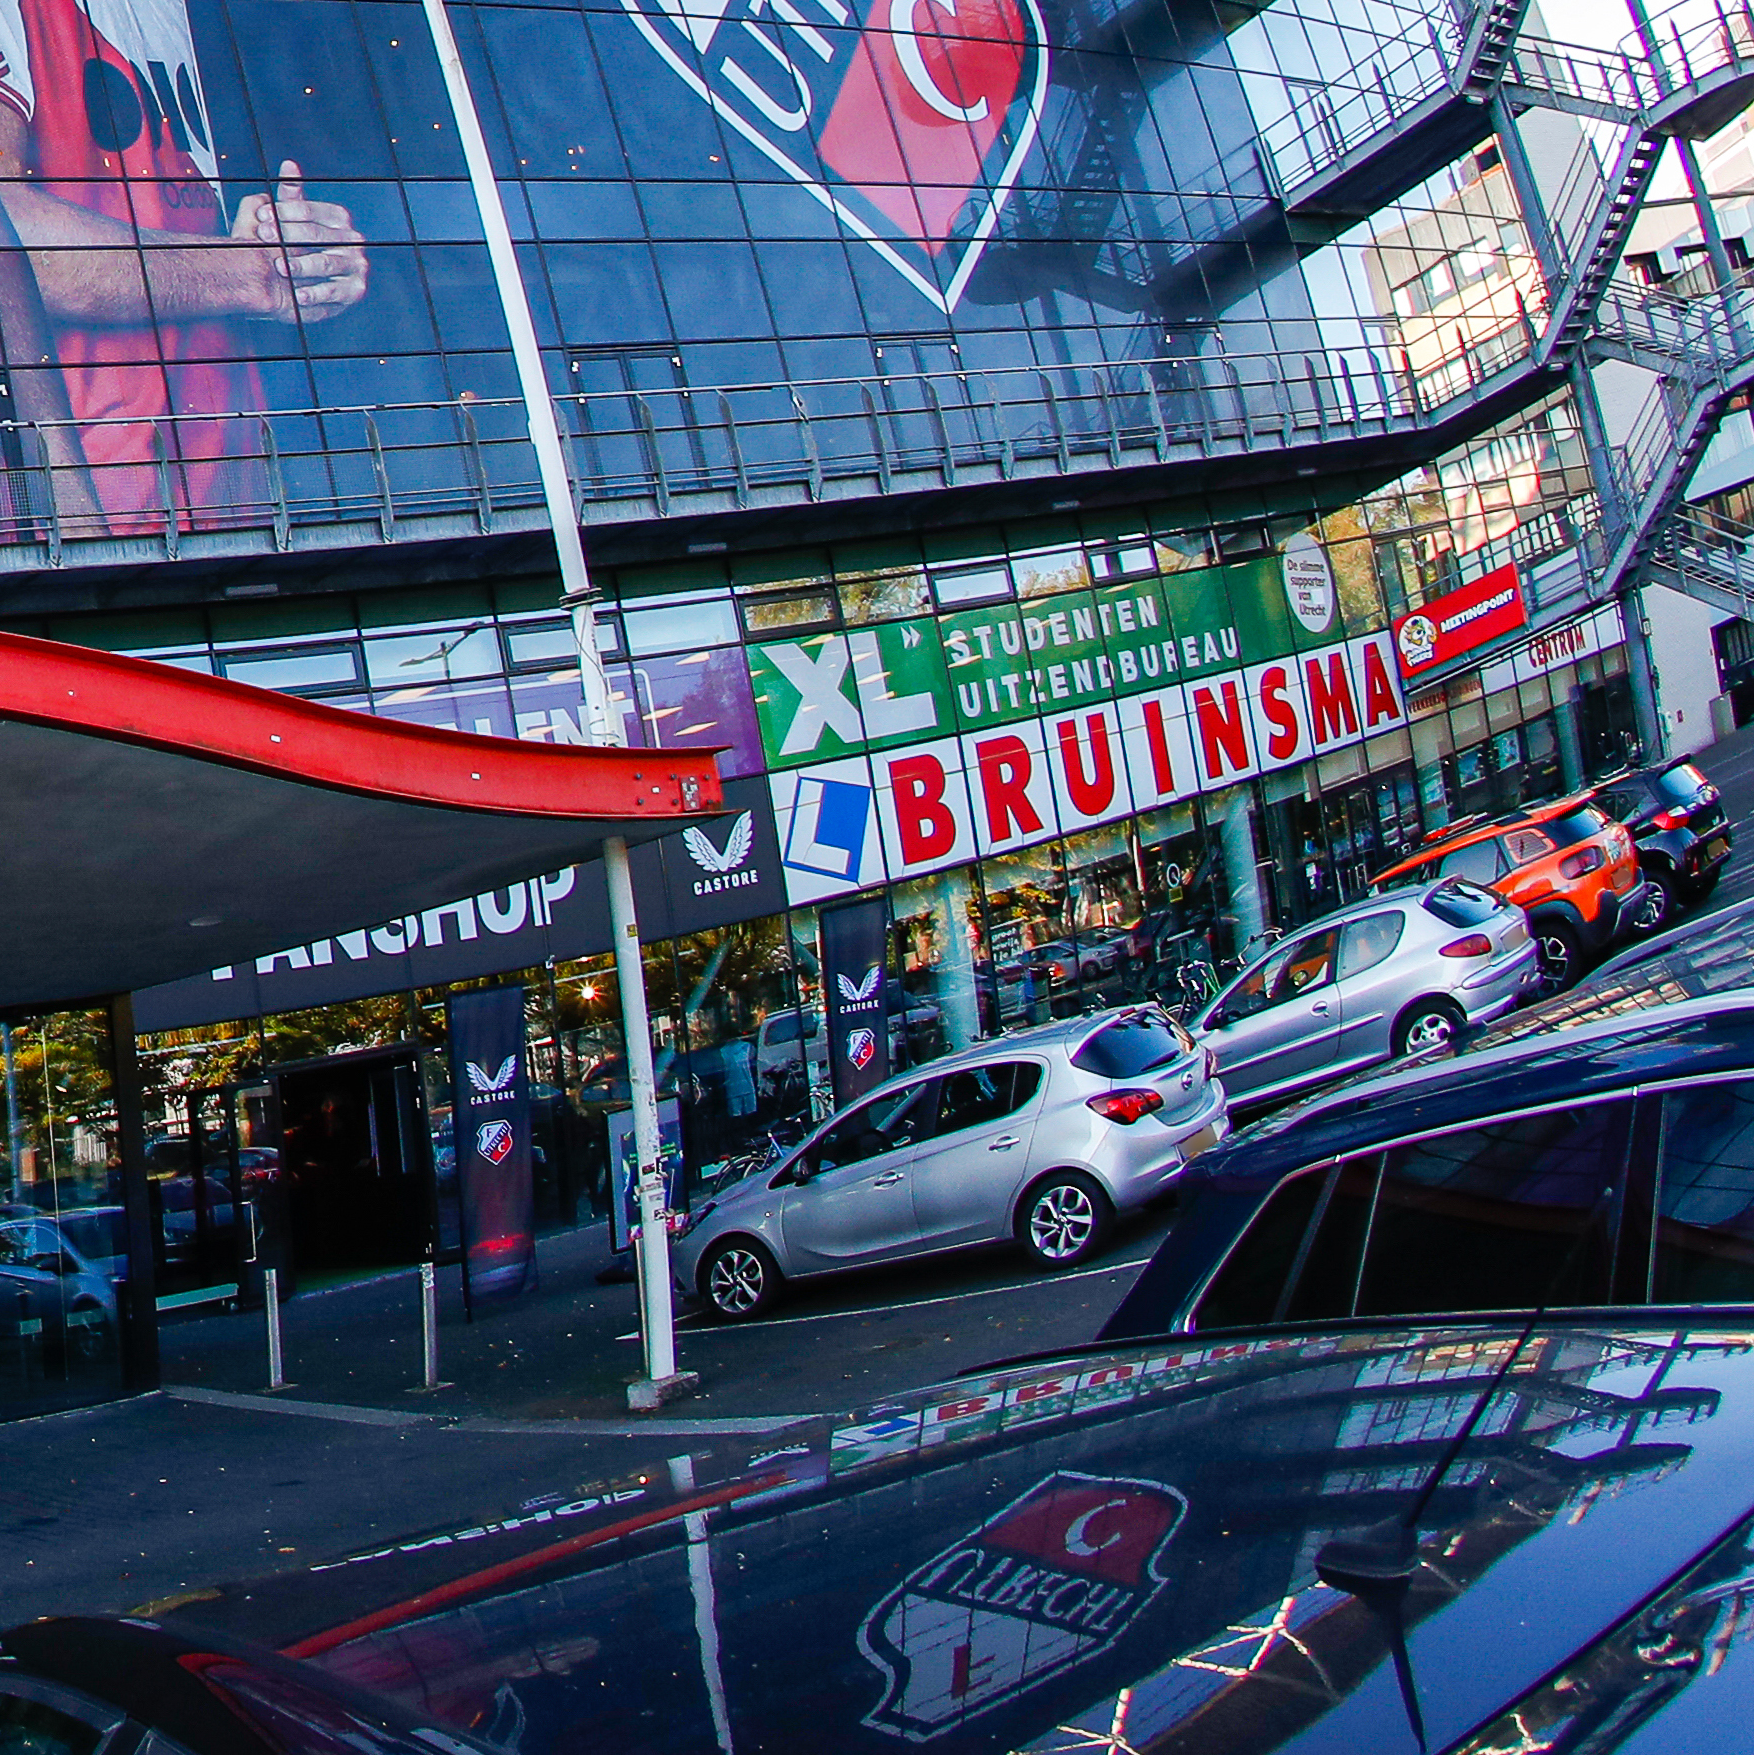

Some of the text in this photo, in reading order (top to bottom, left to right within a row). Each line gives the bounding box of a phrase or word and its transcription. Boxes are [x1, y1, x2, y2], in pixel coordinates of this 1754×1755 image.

[1287, 559, 1325, 573] De slimme
[1290, 575, 1326, 589] supporter
[1299, 603, 1327, 617] Utrecht
[1440, 587, 1516, 633] MEETINGPOINT
[949, 595, 1158, 662] STUDENTEN
[957, 627, 1241, 718] UITZENDBUREAU
[759, 632, 937, 755] XL
[888, 641, 1401, 867] BRUINSMA
[693, 869, 759, 896] CASTORE
[839, 999, 879, 1014] CASTORE
[470, 1090, 515, 1106] CASTORE
